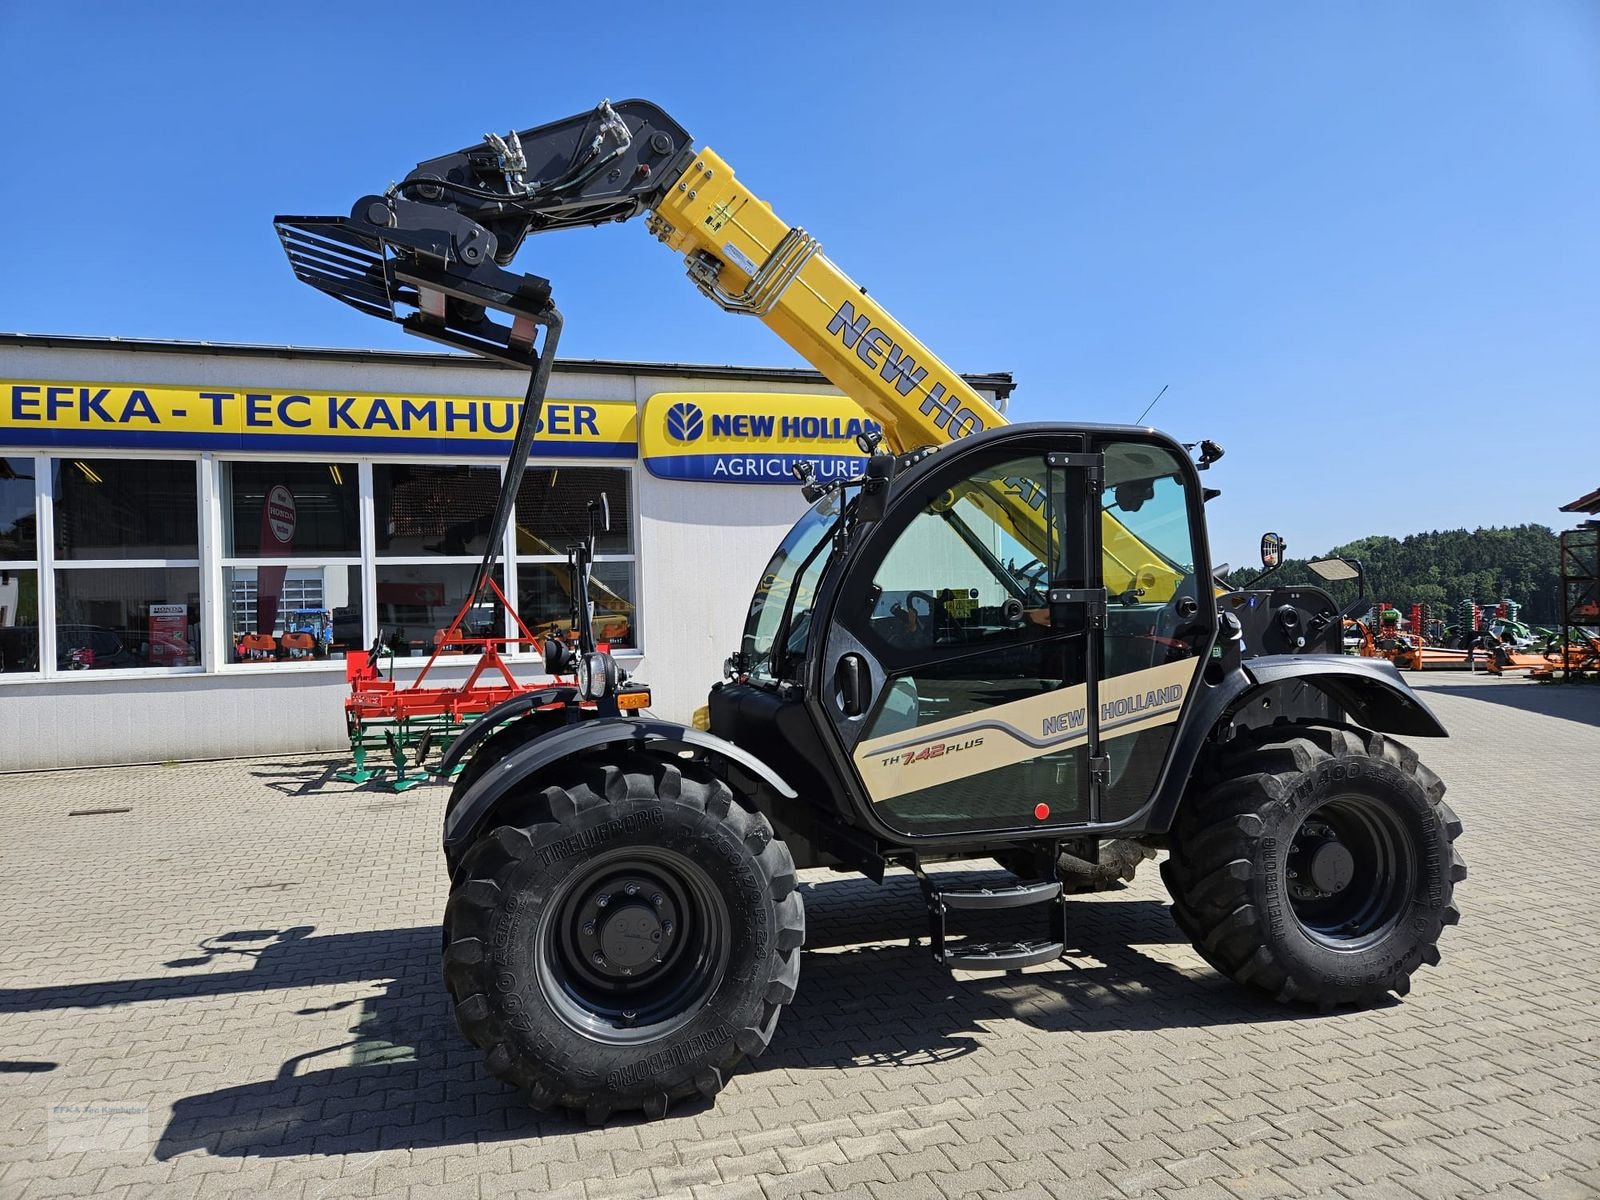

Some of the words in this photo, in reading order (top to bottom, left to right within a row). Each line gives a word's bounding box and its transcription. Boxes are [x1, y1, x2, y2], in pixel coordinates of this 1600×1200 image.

[826, 300, 928, 397] NEW
[712, 414, 775, 438] NEW
[781, 416, 882, 440] HOLLAN
[713, 458, 860, 478] AGRICUTURE
[270, 506, 294, 521] HONDA
[1042, 708, 1086, 737] NEW
[1101, 684, 1184, 722] HOLLAND
[534, 807, 665, 866] TRELLEBORG
[1262, 836, 1286, 942] TRELLEBORG
[606, 1024, 735, 1093] TRELLEBORG
